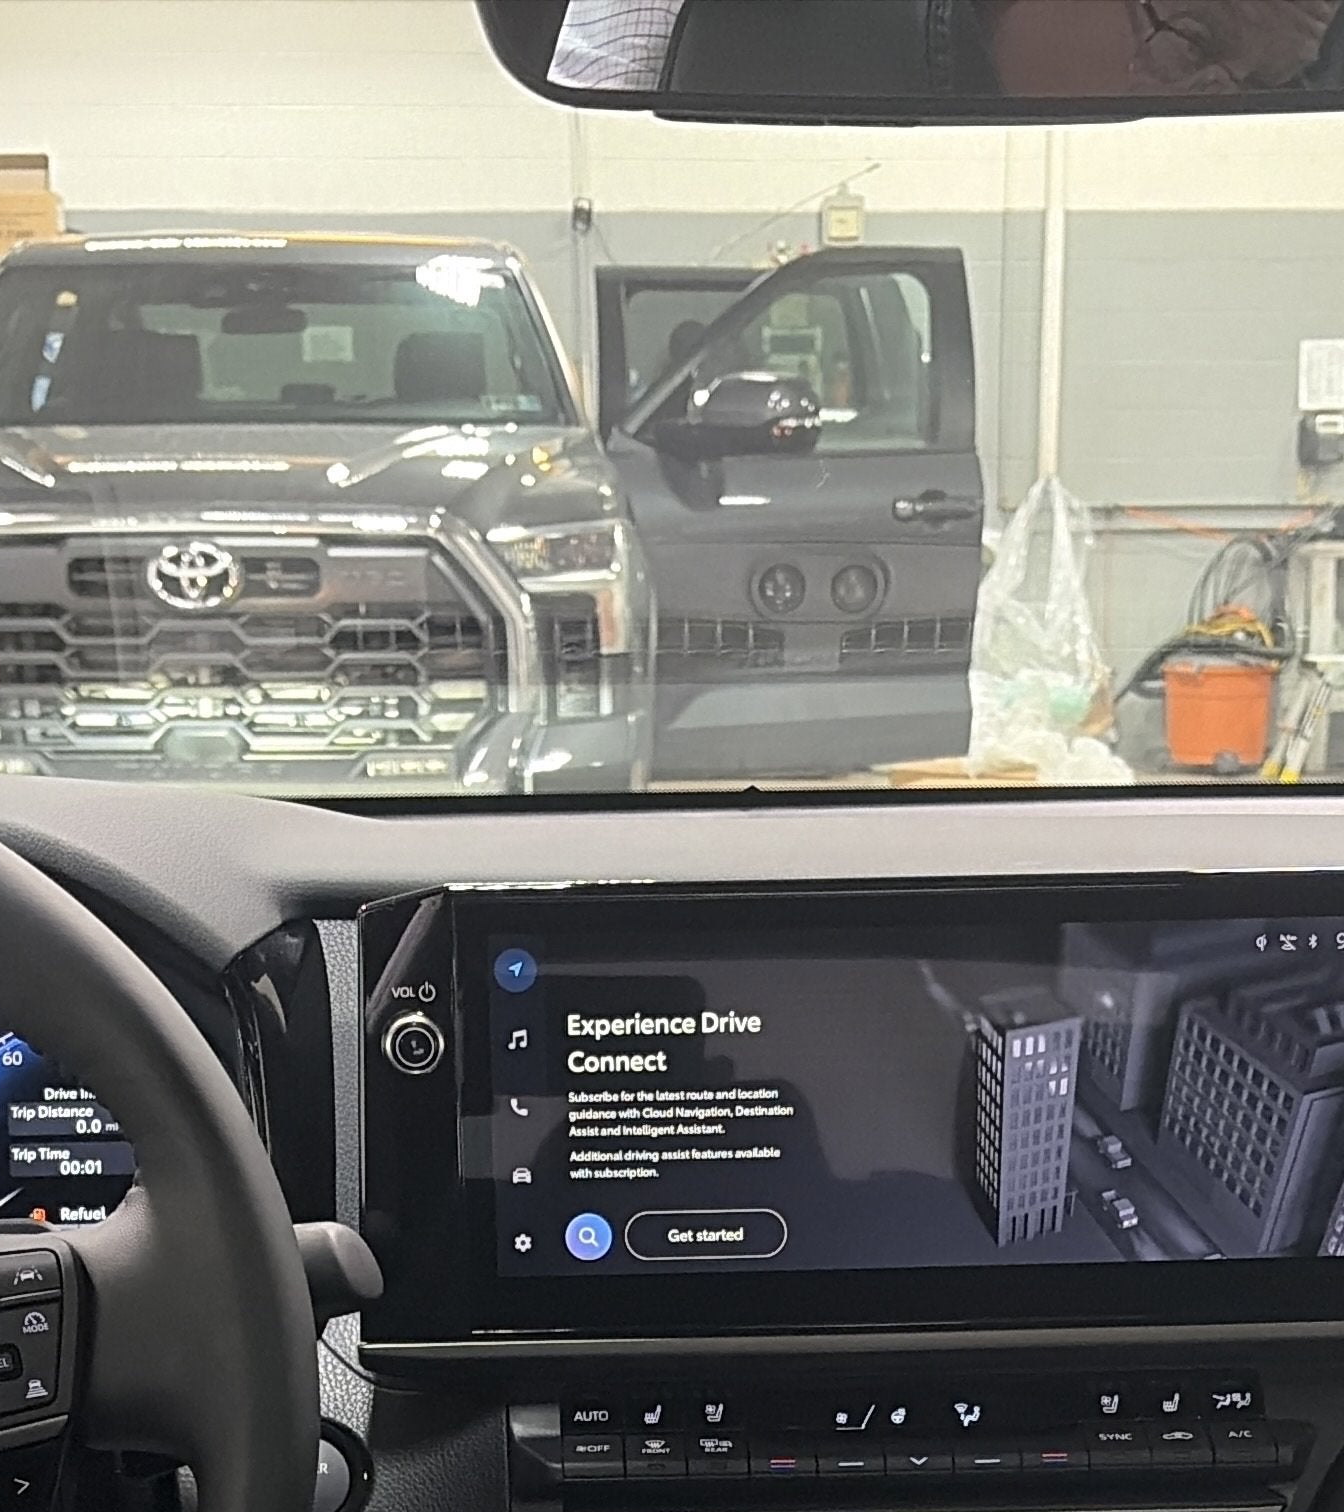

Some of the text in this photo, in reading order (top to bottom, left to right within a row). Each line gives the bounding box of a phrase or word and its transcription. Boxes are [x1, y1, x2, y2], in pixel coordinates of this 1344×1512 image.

[391, 986, 416, 999] VOL
[567, 1010, 762, 1041] Experience Drive
[2, 1051, 23, 1066] 60
[567, 1050, 668, 1073] Connect
[44, 1087, 78, 1100] Drive
[568, 1088, 779, 1103] Subscribe for the latest route and location
[10, 1105, 94, 1121] Trip Distance
[568, 1105, 794, 1122] guidance with Cloud Navigation, Destination
[75, 1119, 119, 1134] 0.0 mi
[568, 1123, 726, 1138] Assist and Intelligent Assistant.
[11, 1147, 71, 1162] Trip Time
[569, 1147, 781, 1163] Additional driving assist features available
[59, 1160, 102, 1176] 00:01
[570, 1167, 659, 1180] with subscription.
[60, 1206, 107, 1221] Refuel
[667, 1227, 745, 1243] Get started
[23, 1322, 49, 1334] MODE
[573, 1410, 609, 1422] AUTO
[1098, 1433, 1133, 1441] SYNC
[1228, 1430, 1253, 1438] A/C
[587, 1445, 611, 1453] OFF
